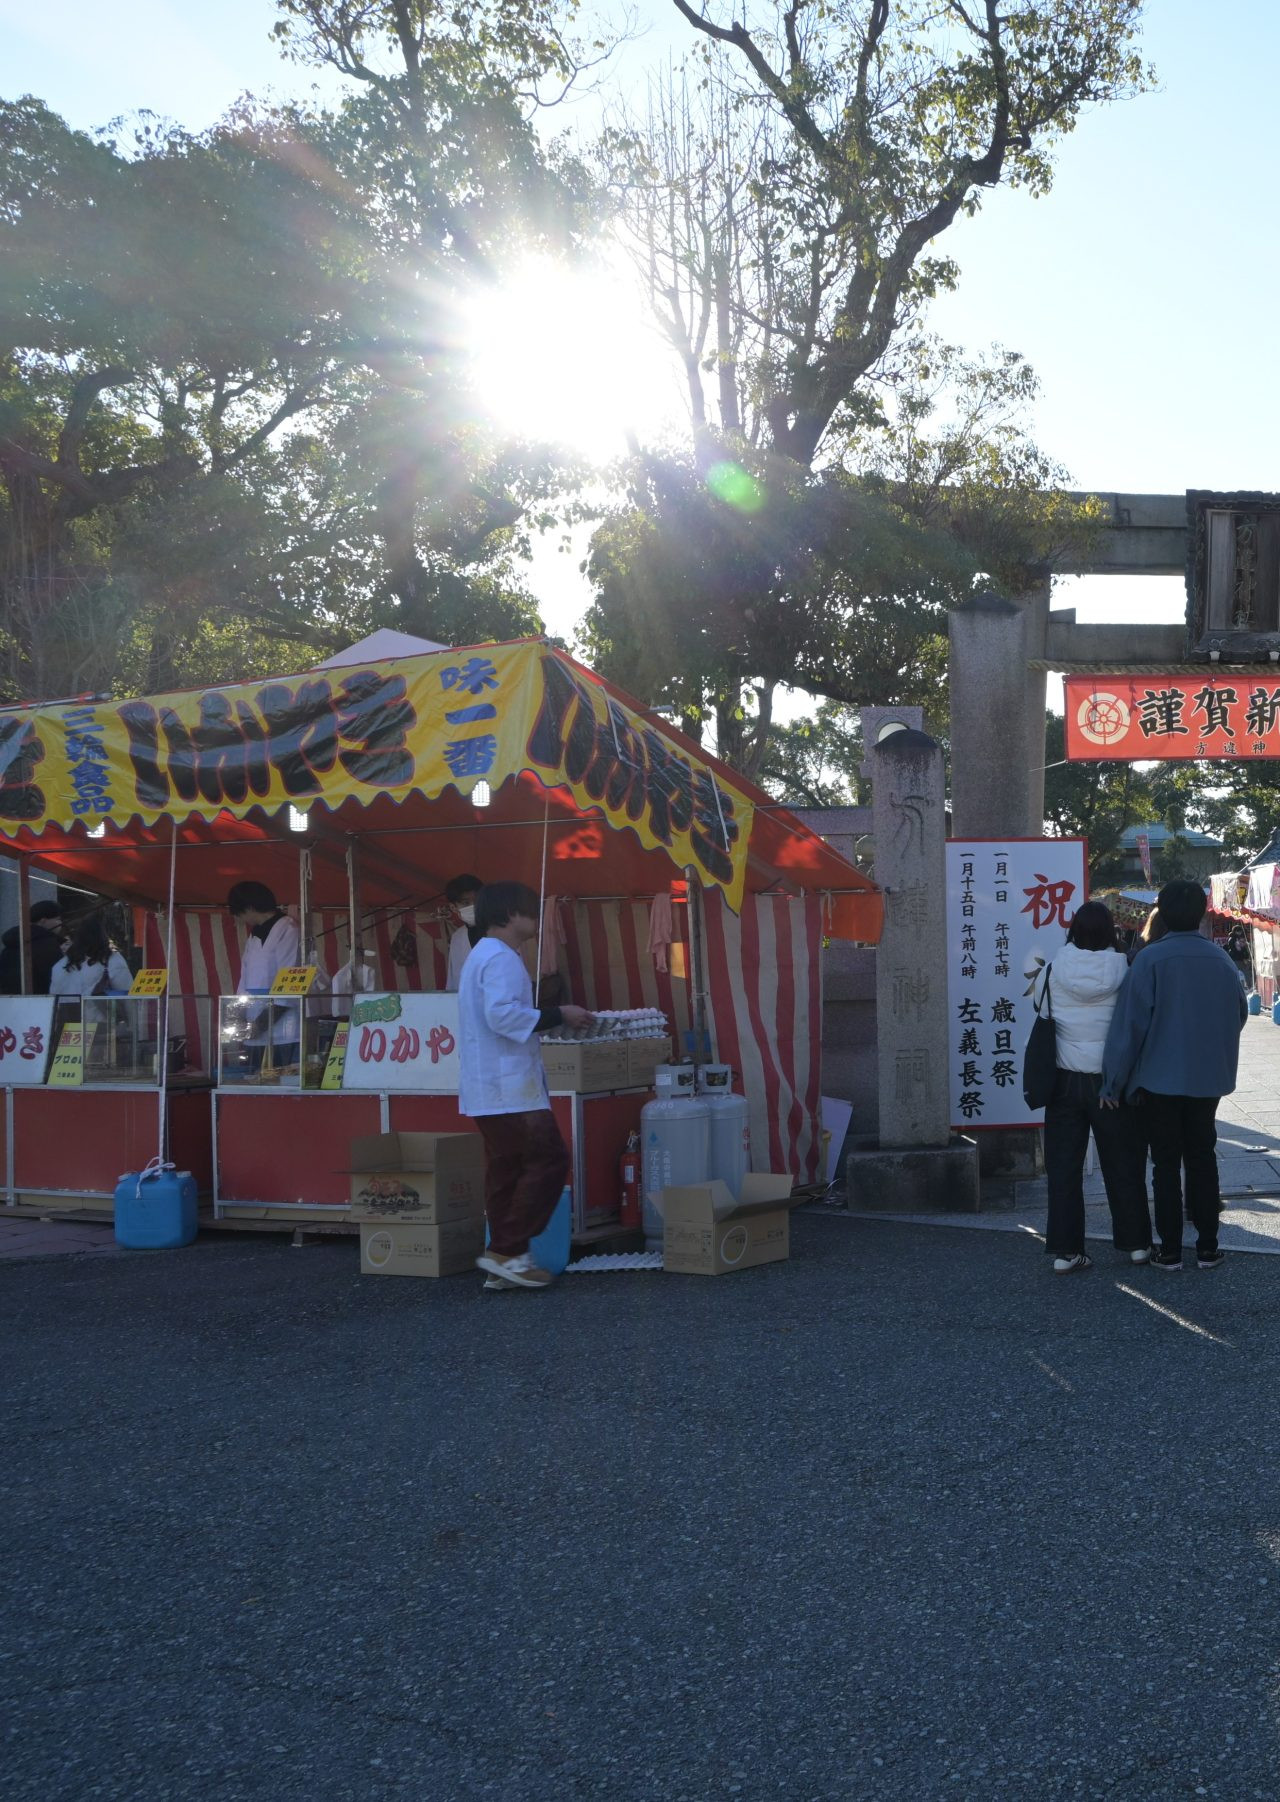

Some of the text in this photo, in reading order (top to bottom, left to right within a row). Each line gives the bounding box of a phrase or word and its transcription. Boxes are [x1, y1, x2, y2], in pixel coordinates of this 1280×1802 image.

[439, 657, 499, 778] 味一番
[1020, 873, 1076, 930] 祝
[957, 853, 985, 1119] 一月十五日 午前八時 左義長祭
[989, 852, 1018, 1087] 一月一日 午前七時 歳旦祭
[358, 1024, 457, 1064] いかや
